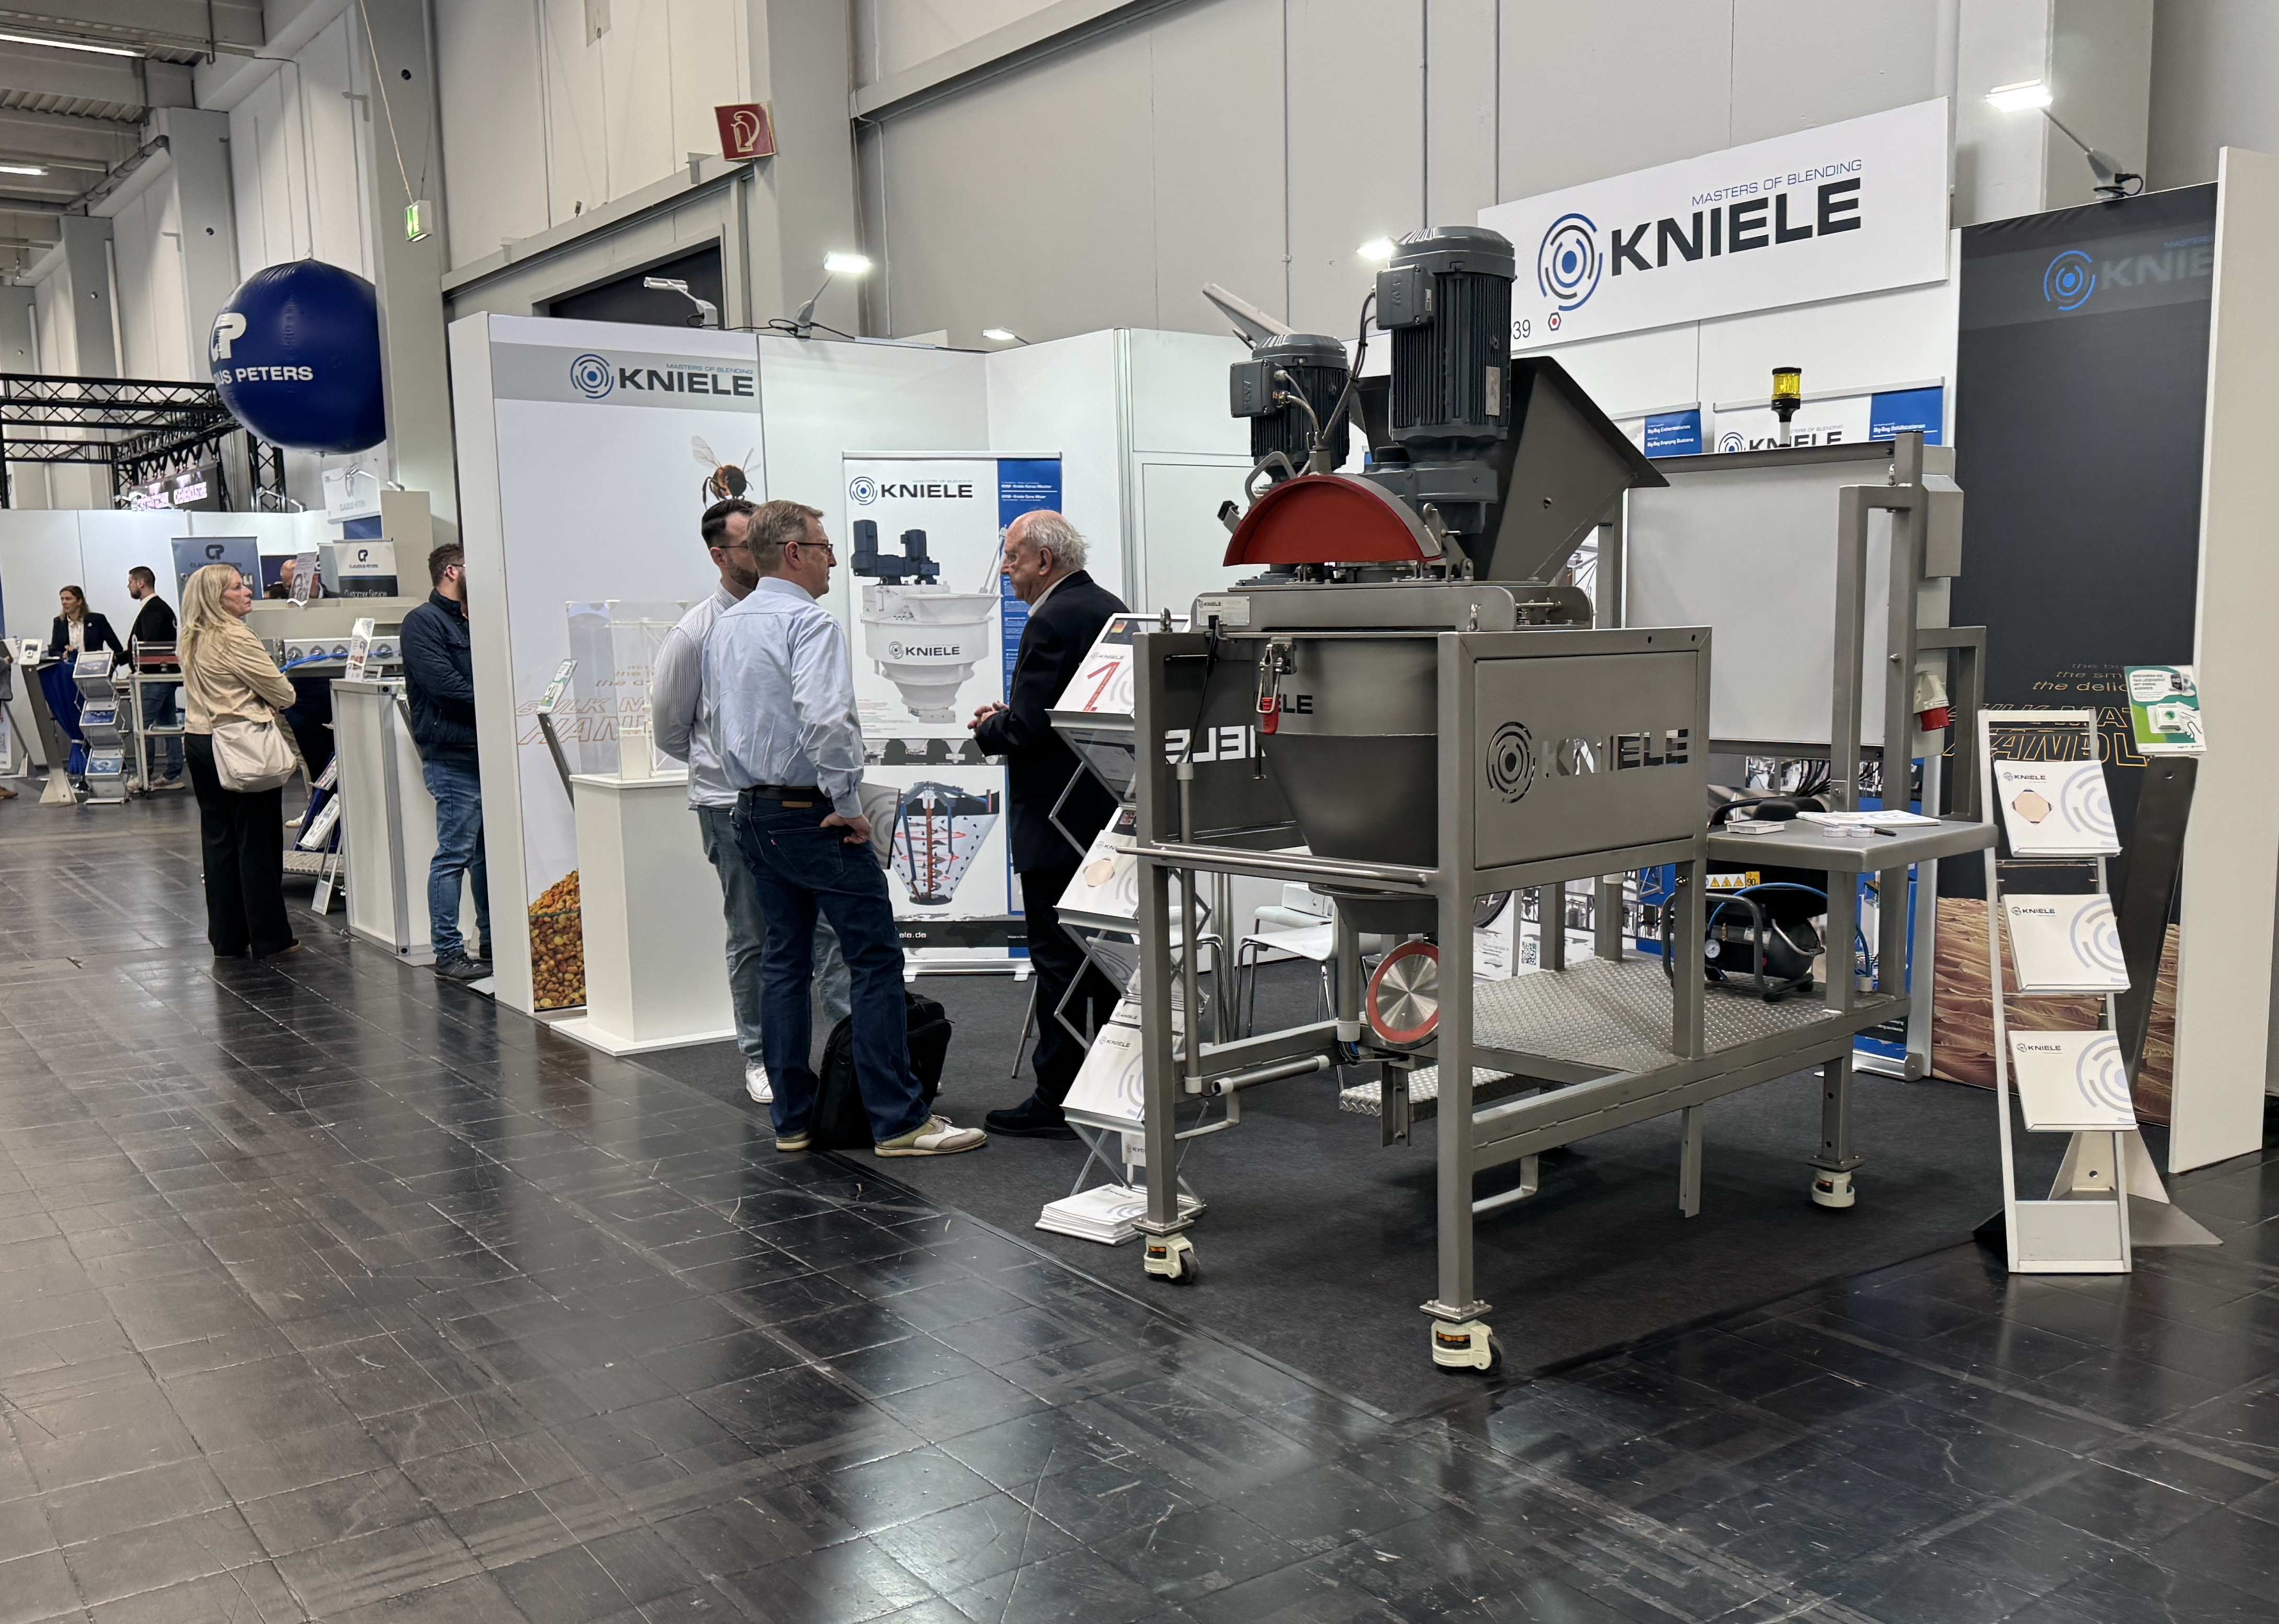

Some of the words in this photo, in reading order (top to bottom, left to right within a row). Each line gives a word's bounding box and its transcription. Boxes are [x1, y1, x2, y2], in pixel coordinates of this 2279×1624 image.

[1692, 181, 1758, 207] MASTERS
[1763, 176, 1783, 191] OF
[1787, 159, 1863, 186] BLENDING
[1612, 177, 1861, 277] KNIELE
[1513, 319, 1531, 340] 39
[235, 366, 314, 383] PETERS
[666, 363, 703, 371] MASTERS
[619, 368, 754, 397] KNIELE
[881, 484, 973, 498] KNIELE
[905, 647, 960, 656] KNIELE
[2033, 681, 2068, 691] the
[1541, 728, 1689, 779] KNIELE
[1747, 878, 1756, 886] 90
